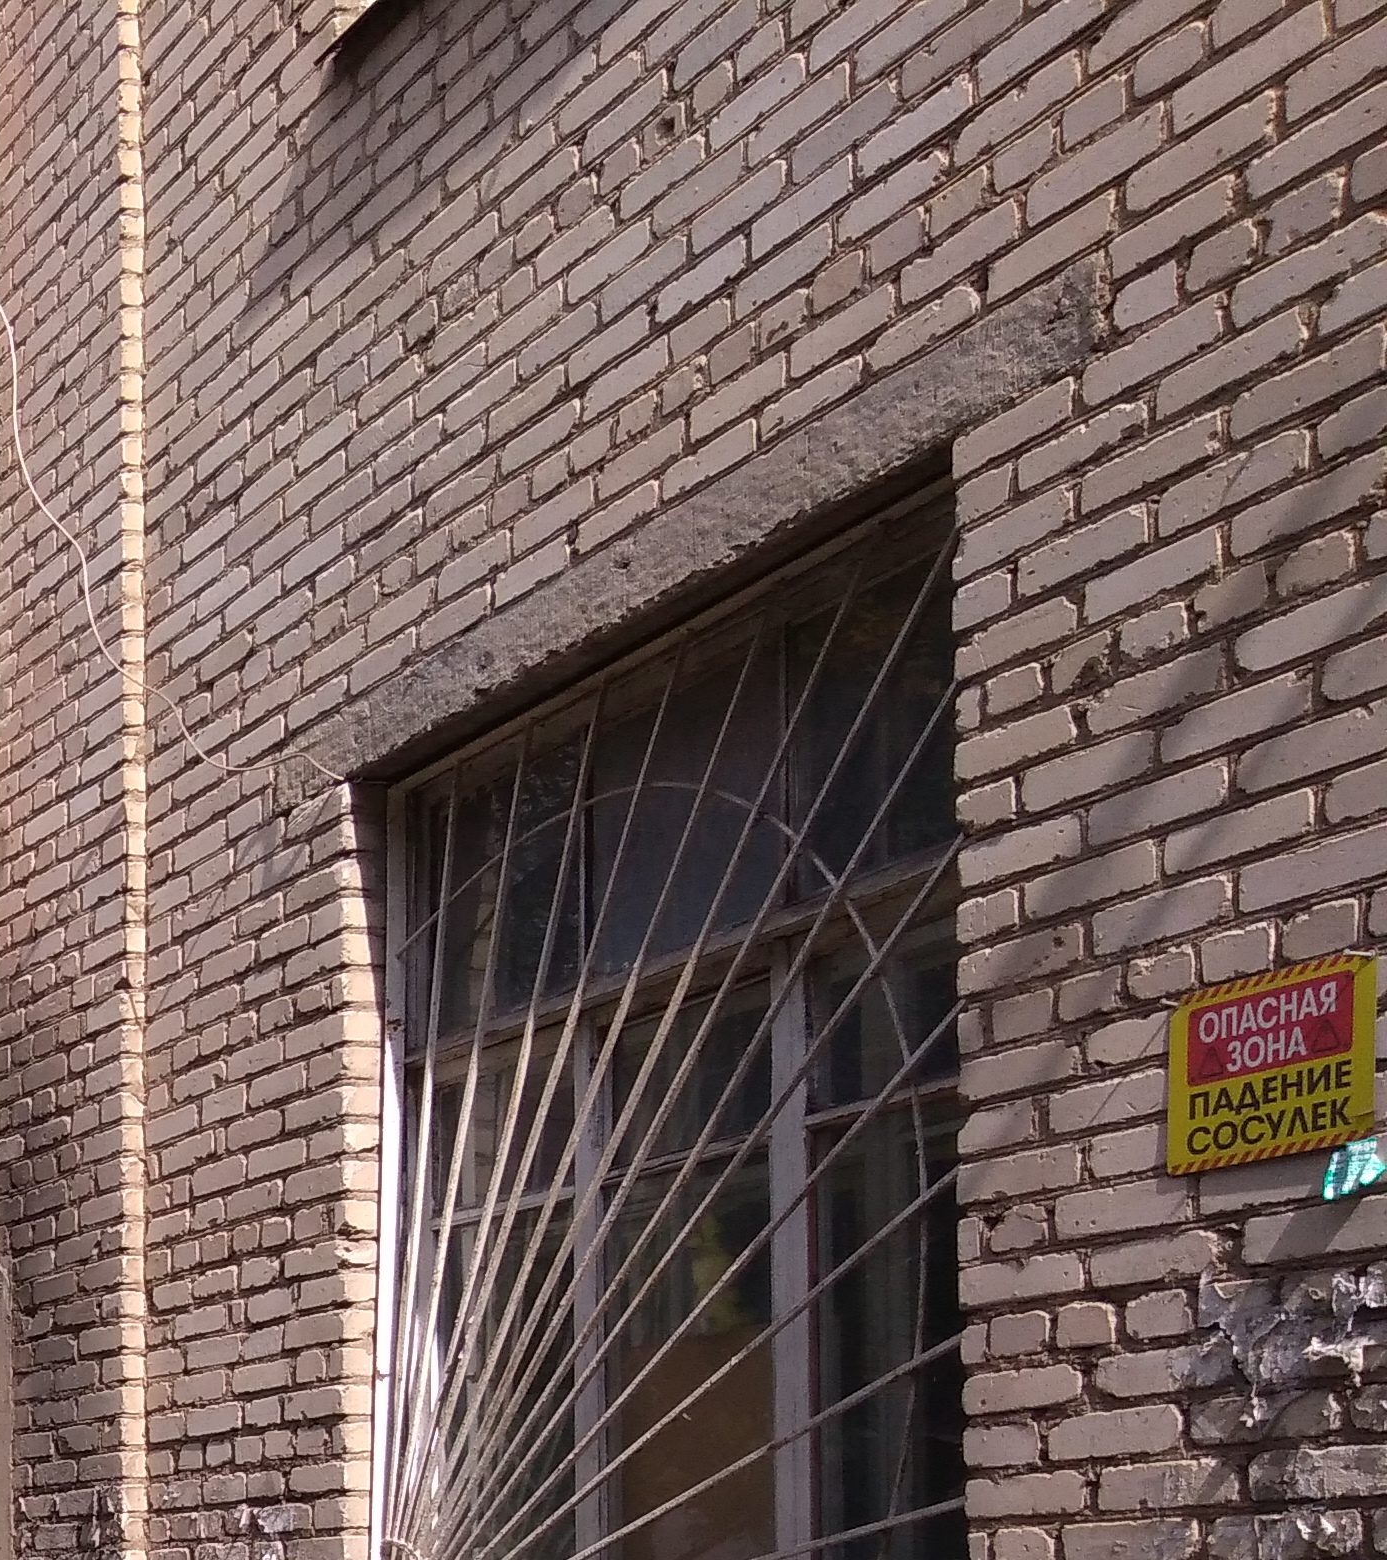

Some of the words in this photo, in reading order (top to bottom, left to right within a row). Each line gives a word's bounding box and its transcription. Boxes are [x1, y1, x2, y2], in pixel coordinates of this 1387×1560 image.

[1198, 981, 1337, 1043] ОПАСНАЯ
[1226, 1026, 1307, 1072] ЗОНА
[1189, 1059, 1352, 1120] ПАДЕНИЕ
[1187, 1096, 1352, 1155] СОСУЛЕК
